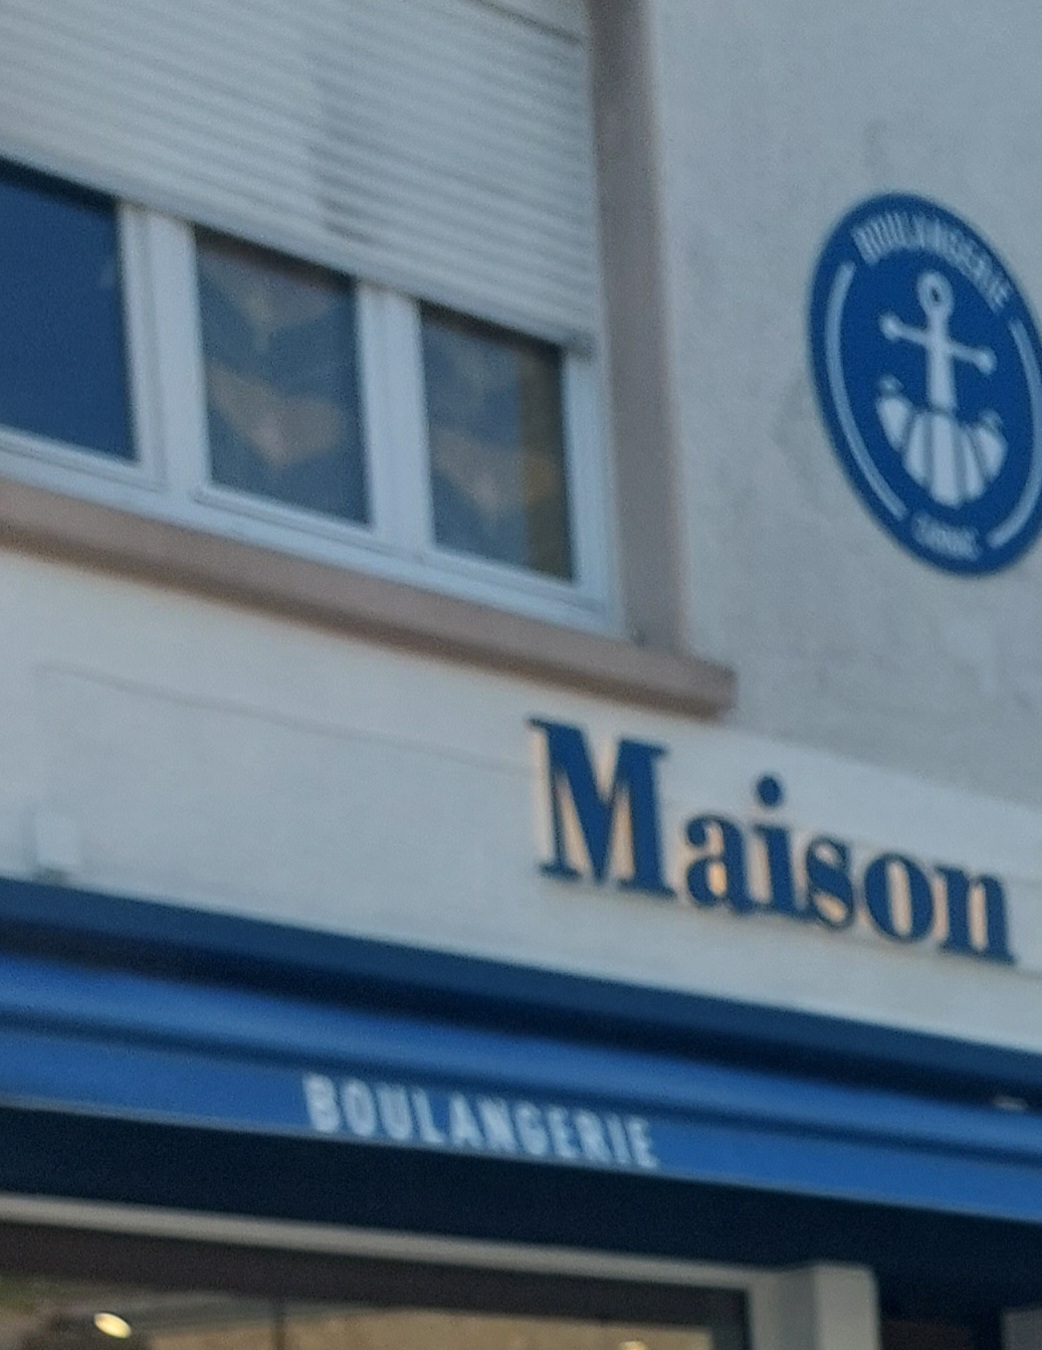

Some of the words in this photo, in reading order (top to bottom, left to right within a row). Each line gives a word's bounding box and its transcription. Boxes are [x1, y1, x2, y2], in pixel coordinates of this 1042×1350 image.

[852, 210, 1014, 314] BOULANGERIE
[527, 715, 1015, 966] Maison
[303, 1071, 660, 1170] BOULANGERIE
